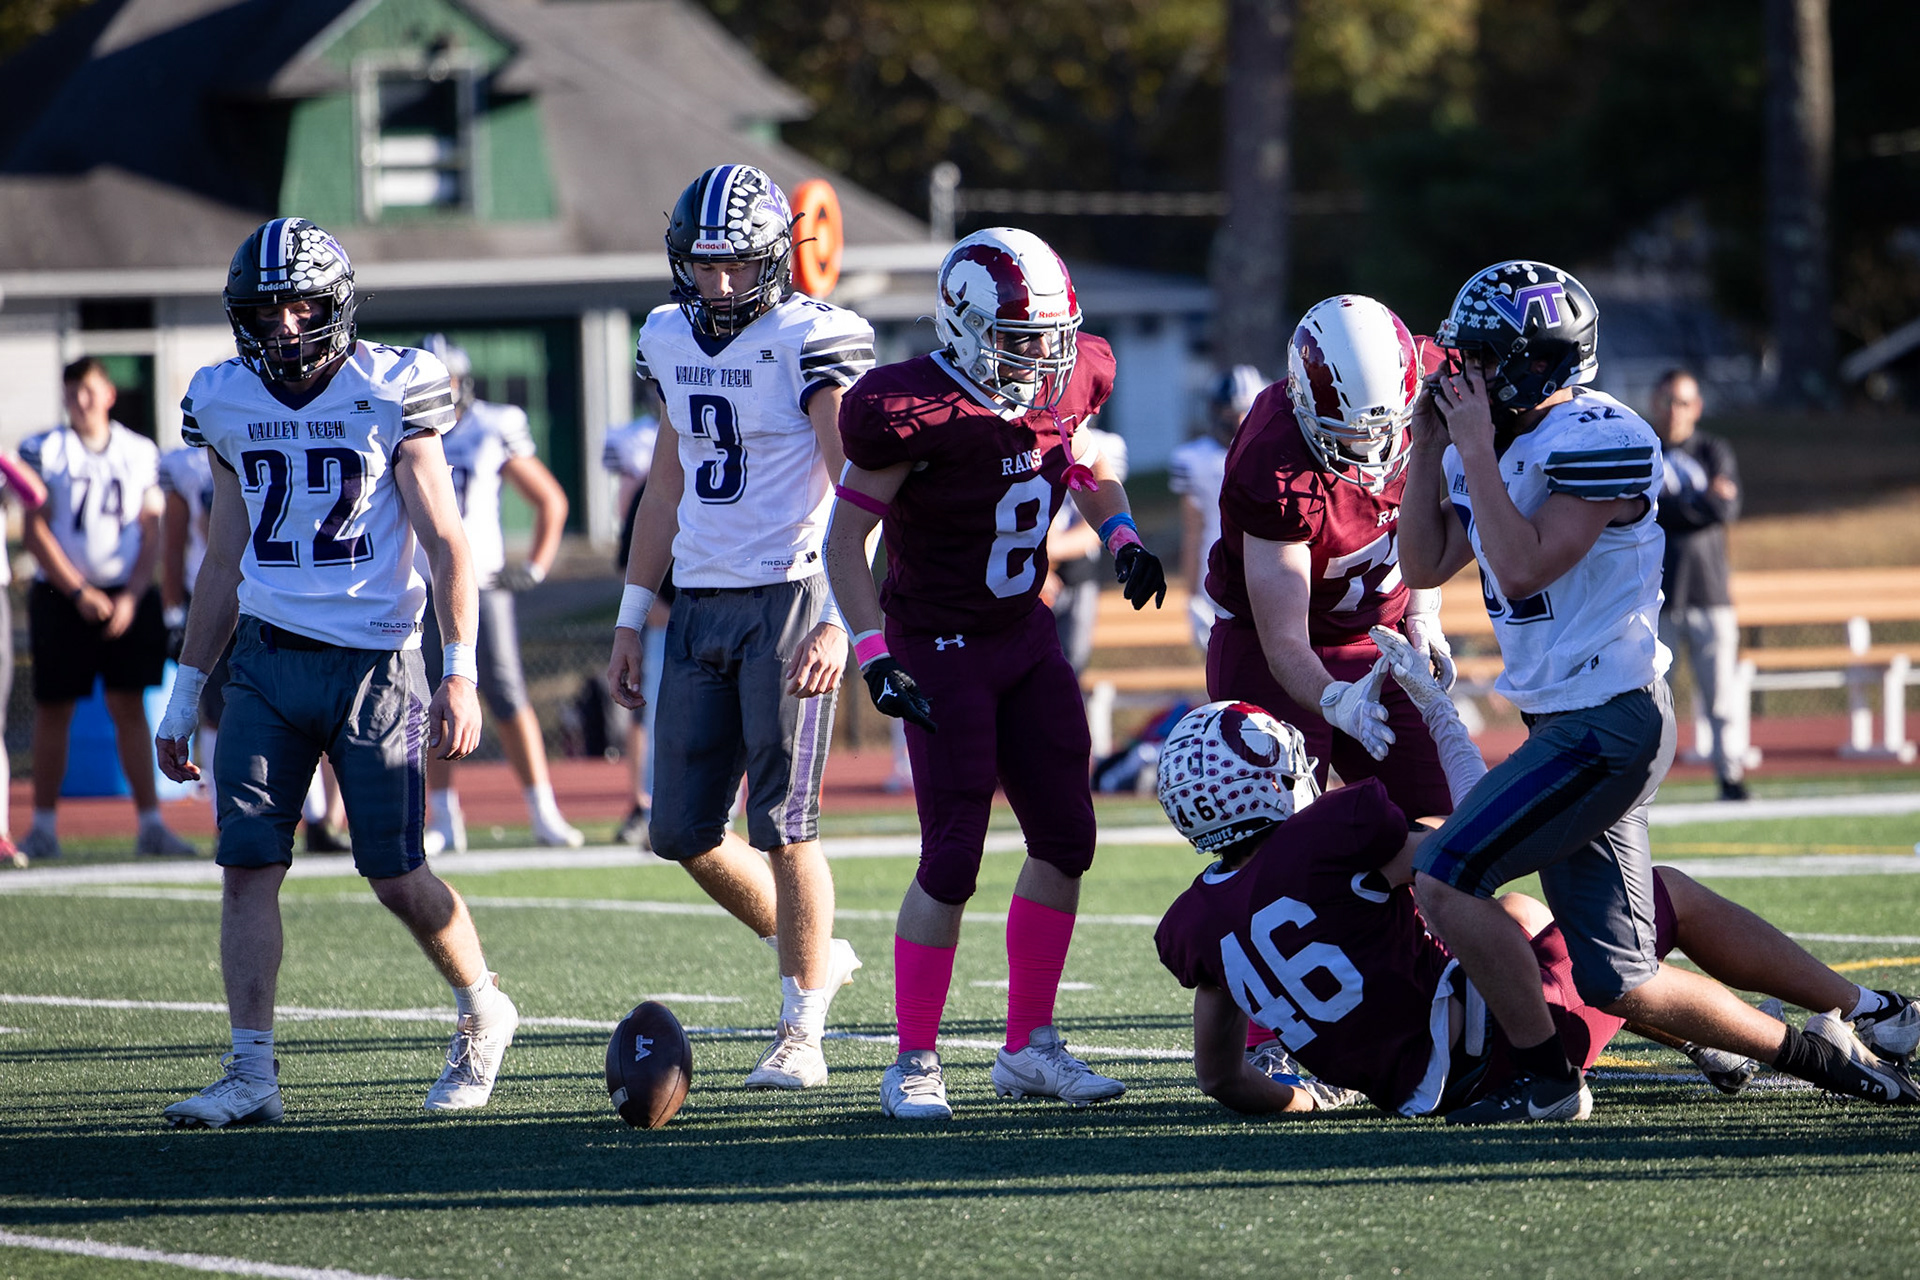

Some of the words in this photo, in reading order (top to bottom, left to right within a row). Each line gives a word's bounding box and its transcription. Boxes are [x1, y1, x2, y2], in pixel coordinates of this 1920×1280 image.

[696, 242, 727, 250] Riddell
[258, 281, 291, 291] Riddell
[1487, 282, 1566, 335] VT
[675, 366, 716, 386] VALLEY
[720, 368, 752, 387] TECH
[1569, 406, 1624, 424] 32
[247, 420, 299, 442] VALLEY
[305, 420, 346, 440] TECH
[689, 394, 748, 505] 3
[1001, 448, 1043, 476] RAMS
[71, 477, 123, 533] 74
[240, 447, 374, 568] 22
[1376, 506, 1400, 527] RA
[985, 474, 1052, 599] 8
[1197, 827, 1234, 848] schutt
[1220, 896, 1364, 1053] 46
[635, 1034, 654, 1062] VT
